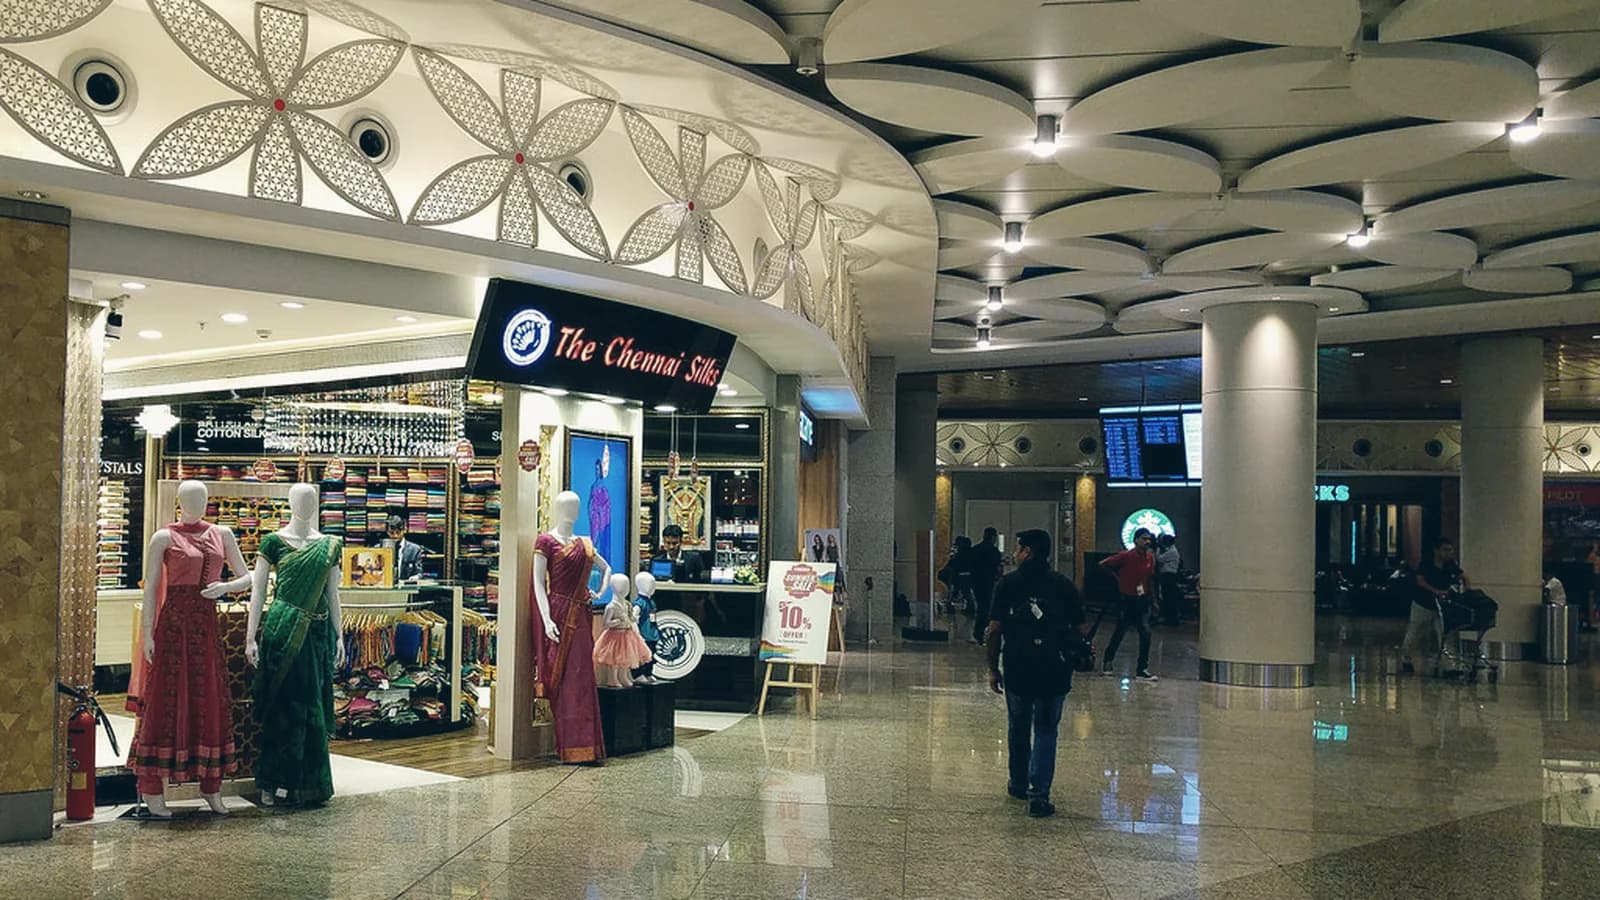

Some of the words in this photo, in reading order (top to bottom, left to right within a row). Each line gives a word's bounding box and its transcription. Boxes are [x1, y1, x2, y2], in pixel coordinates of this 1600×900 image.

[554, 325, 597, 362] The
[604, 335, 686, 378] Chennai
[684, 354, 720, 387] Silks
[197, 428, 241, 438] COTTON
[491, 431, 502, 441] S
